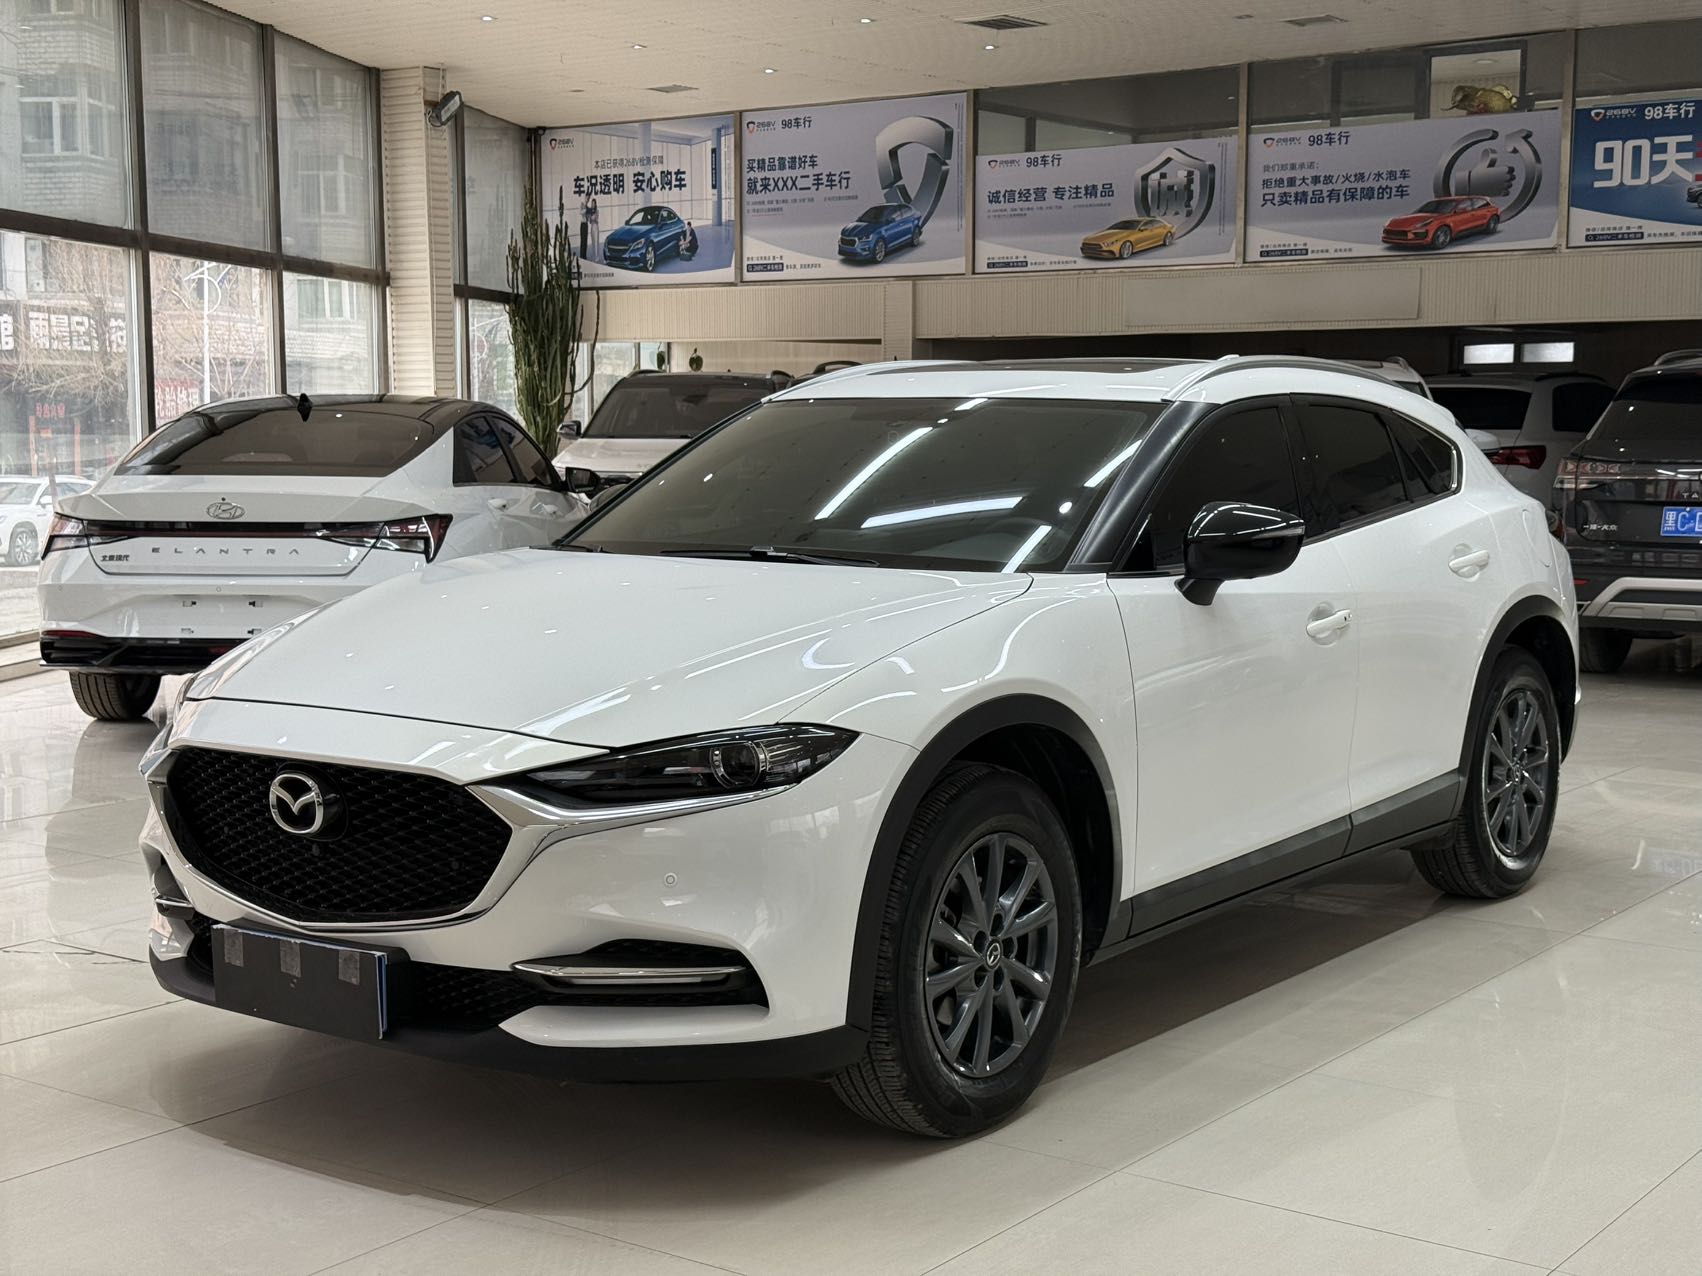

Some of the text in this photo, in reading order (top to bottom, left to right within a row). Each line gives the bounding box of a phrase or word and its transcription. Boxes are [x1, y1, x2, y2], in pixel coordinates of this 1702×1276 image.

[1644, 102, 1696, 120] 98车行
[781, 116, 812, 129] 98车行
[1308, 131, 1351, 146] 98车行
[747, 154, 818, 174] 买精品靠谱好车
[1026, 154, 1062, 168] 98车行
[1593, 135, 1694, 188] 90天
[573, 173, 625, 197] 车况透明
[632, 169, 687, 191] 安心购车
[747, 171, 851, 195] 就来XXX二手车行
[1261, 169, 1411, 190] 拒绝重大事故/火烧/水泡车
[987, 183, 1115, 205] 诚信经营 专注精品
[1261, 184, 1410, 208] 只卖精品有保障的车
[152, 547, 299, 555] ELANTRA
